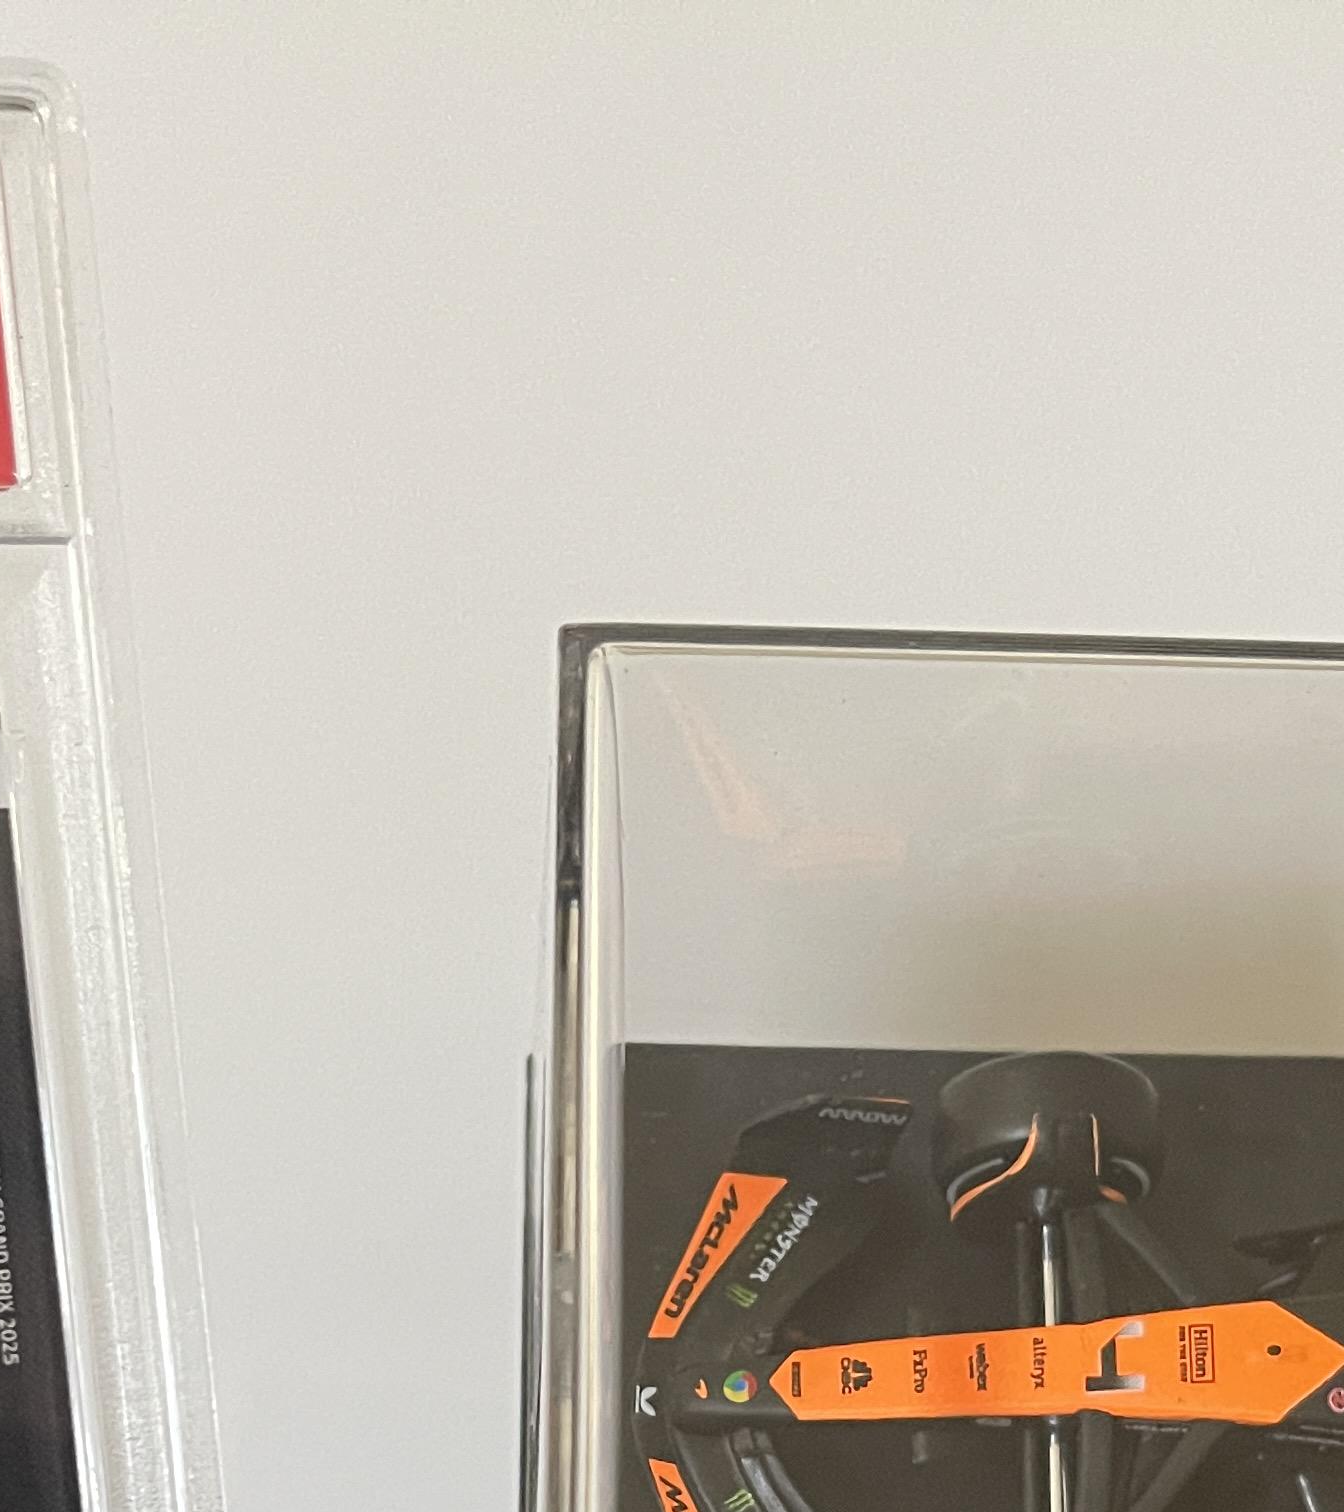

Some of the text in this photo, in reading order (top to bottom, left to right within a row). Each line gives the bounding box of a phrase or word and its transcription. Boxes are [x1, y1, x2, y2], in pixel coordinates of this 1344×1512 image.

[663, 1184, 740, 1320] McLaren
[749, 1194, 819, 1284] MONSTER
[1031, 1336, 1047, 1389] alteryx
[1193, 1329, 1208, 1378] Hilton
